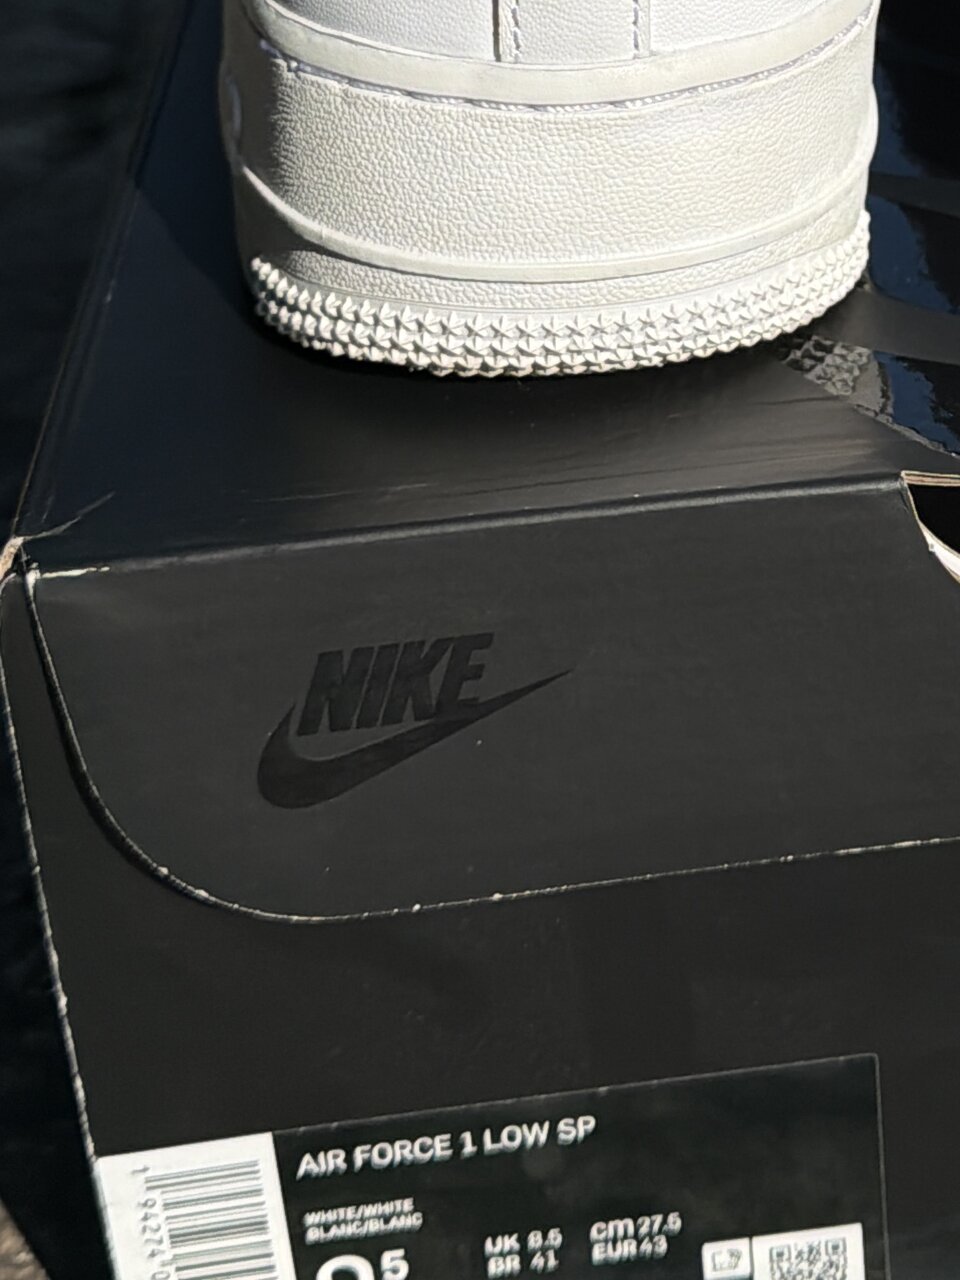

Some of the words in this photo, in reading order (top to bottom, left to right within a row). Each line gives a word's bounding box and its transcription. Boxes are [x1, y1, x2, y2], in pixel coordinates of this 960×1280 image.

[297, 632, 495, 736] NIKE
[296, 1148, 347, 1180] AIR
[353, 1133, 453, 1172] FORCE
[460, 1130, 478, 1159] 1
[483, 1120, 550, 1154] LOW
[556, 1115, 597, 1145] SP
[303, 1197, 415, 1227] WHITE/WHITE
[305, 1211, 424, 1245] BLANC/BLANC
[484, 1232, 521, 1258] UK
